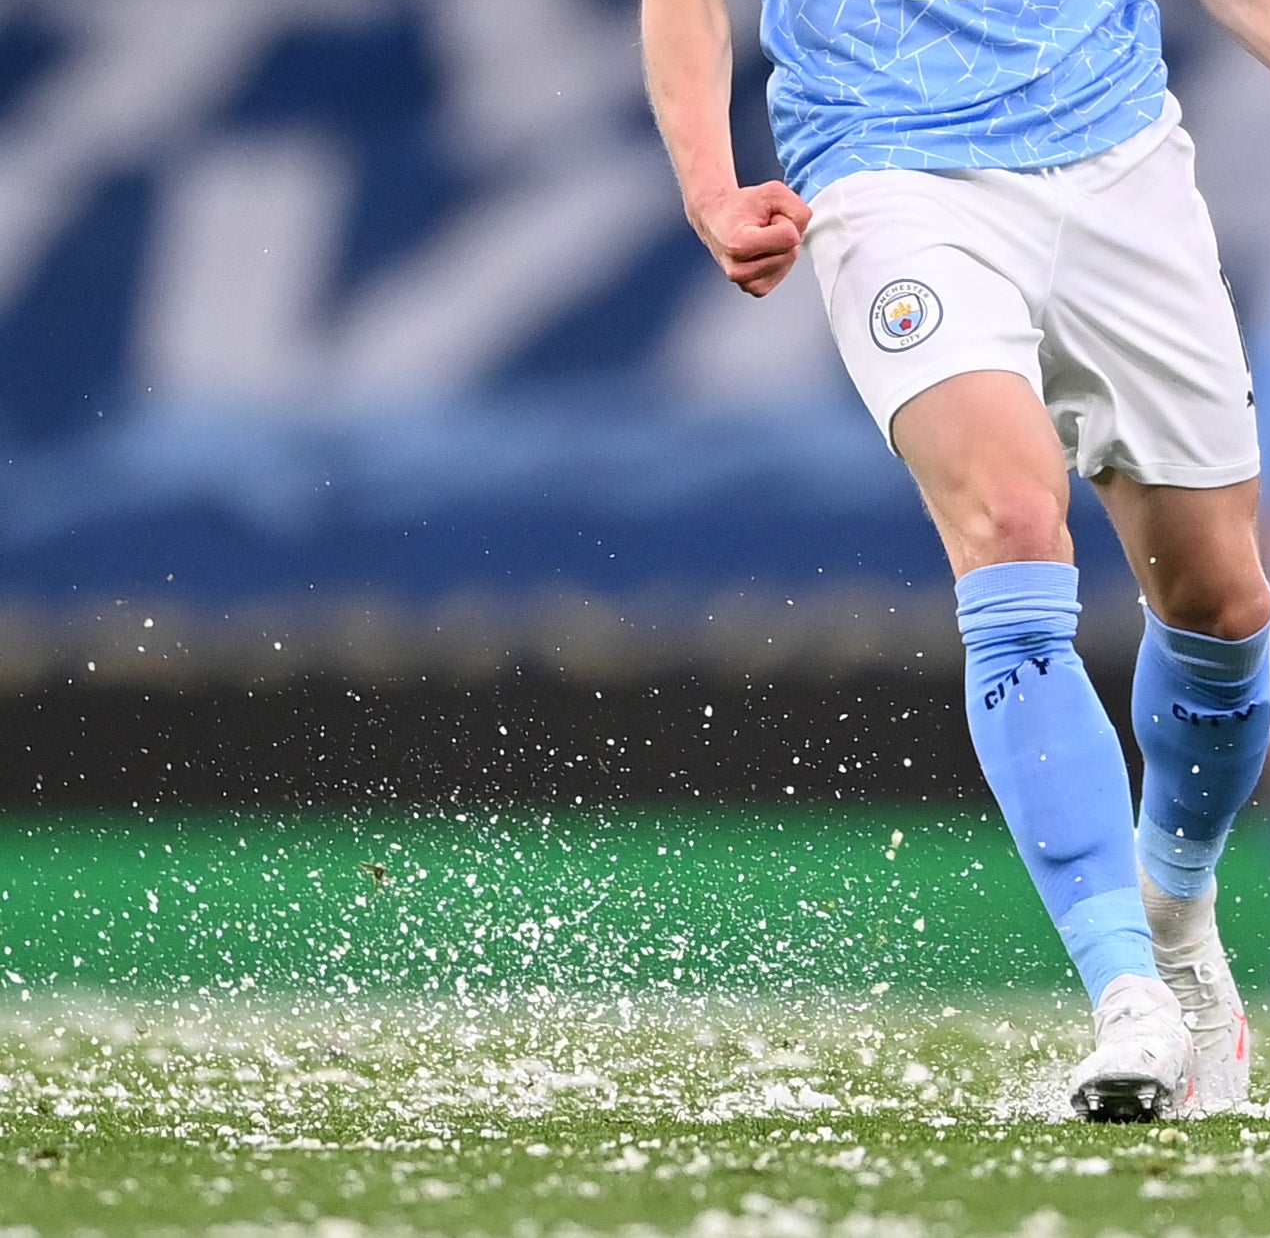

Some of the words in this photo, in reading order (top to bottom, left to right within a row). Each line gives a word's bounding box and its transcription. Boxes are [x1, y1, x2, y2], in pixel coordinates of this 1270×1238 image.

[874, 284, 930, 319] MANCHESTER
[899, 332, 921, 346] CITY
[984, 657, 1051, 711] CITY
[1171, 703, 1259, 727] CITY
